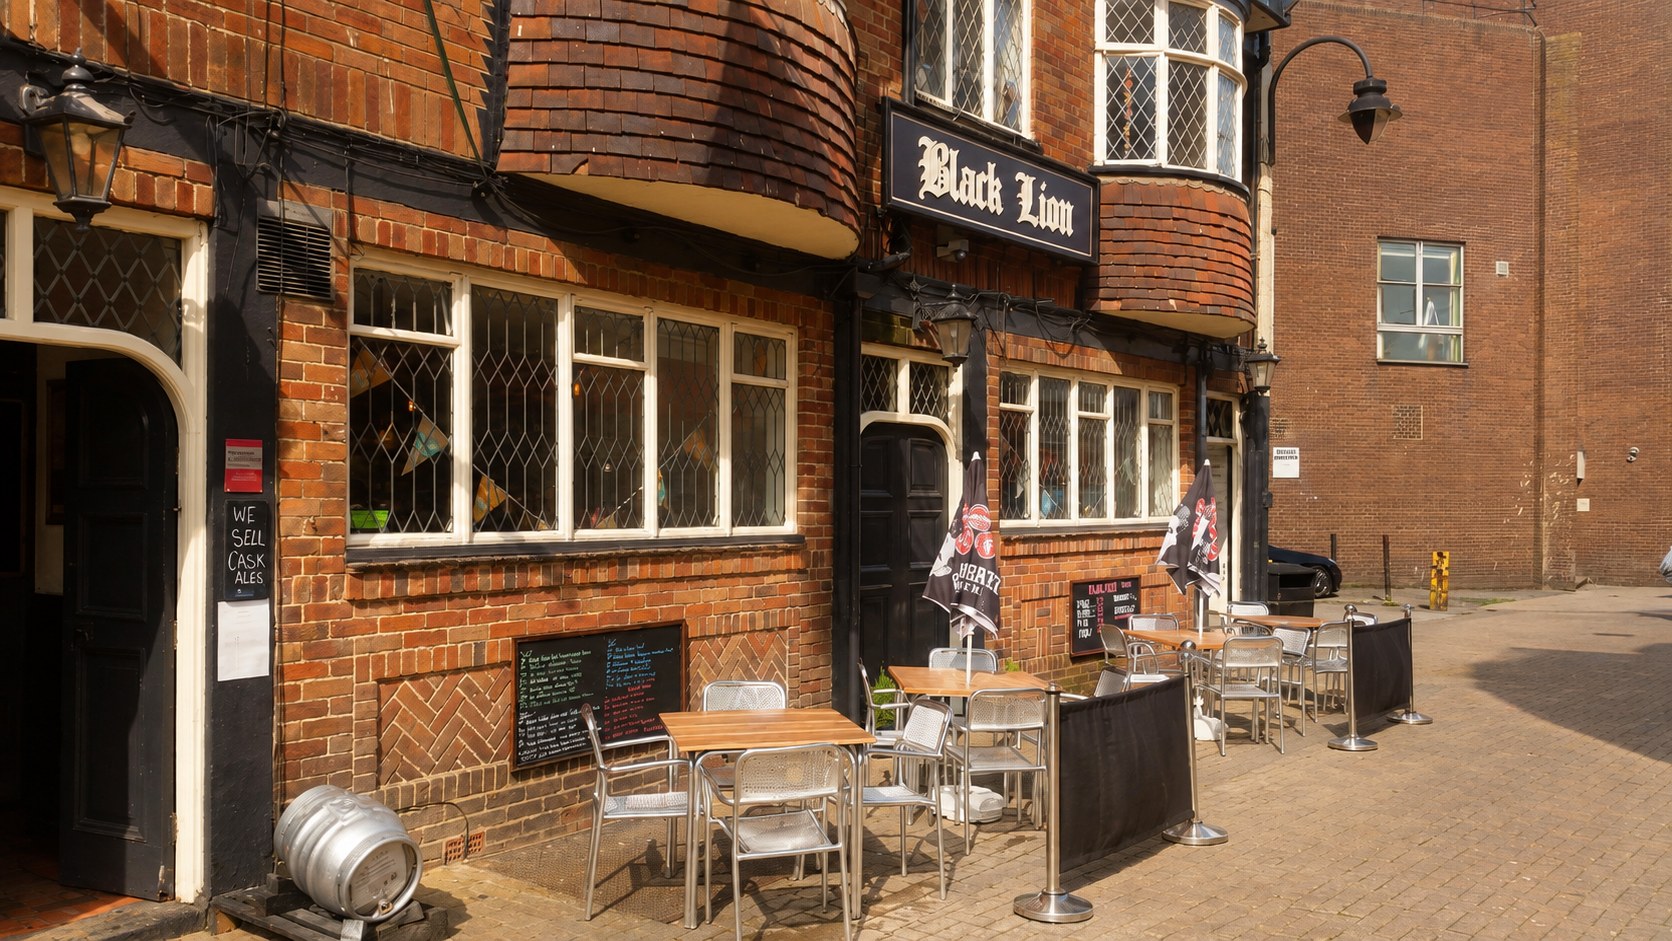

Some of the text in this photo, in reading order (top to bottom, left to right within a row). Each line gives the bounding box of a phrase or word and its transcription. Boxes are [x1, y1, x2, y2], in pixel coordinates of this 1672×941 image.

[918, 136, 1074, 237] Black Lion
[233, 506, 256, 524] WE
[231, 528, 266, 548] SELL
[228, 550, 266, 571] CASK
[234, 571, 264, 585] ALES
